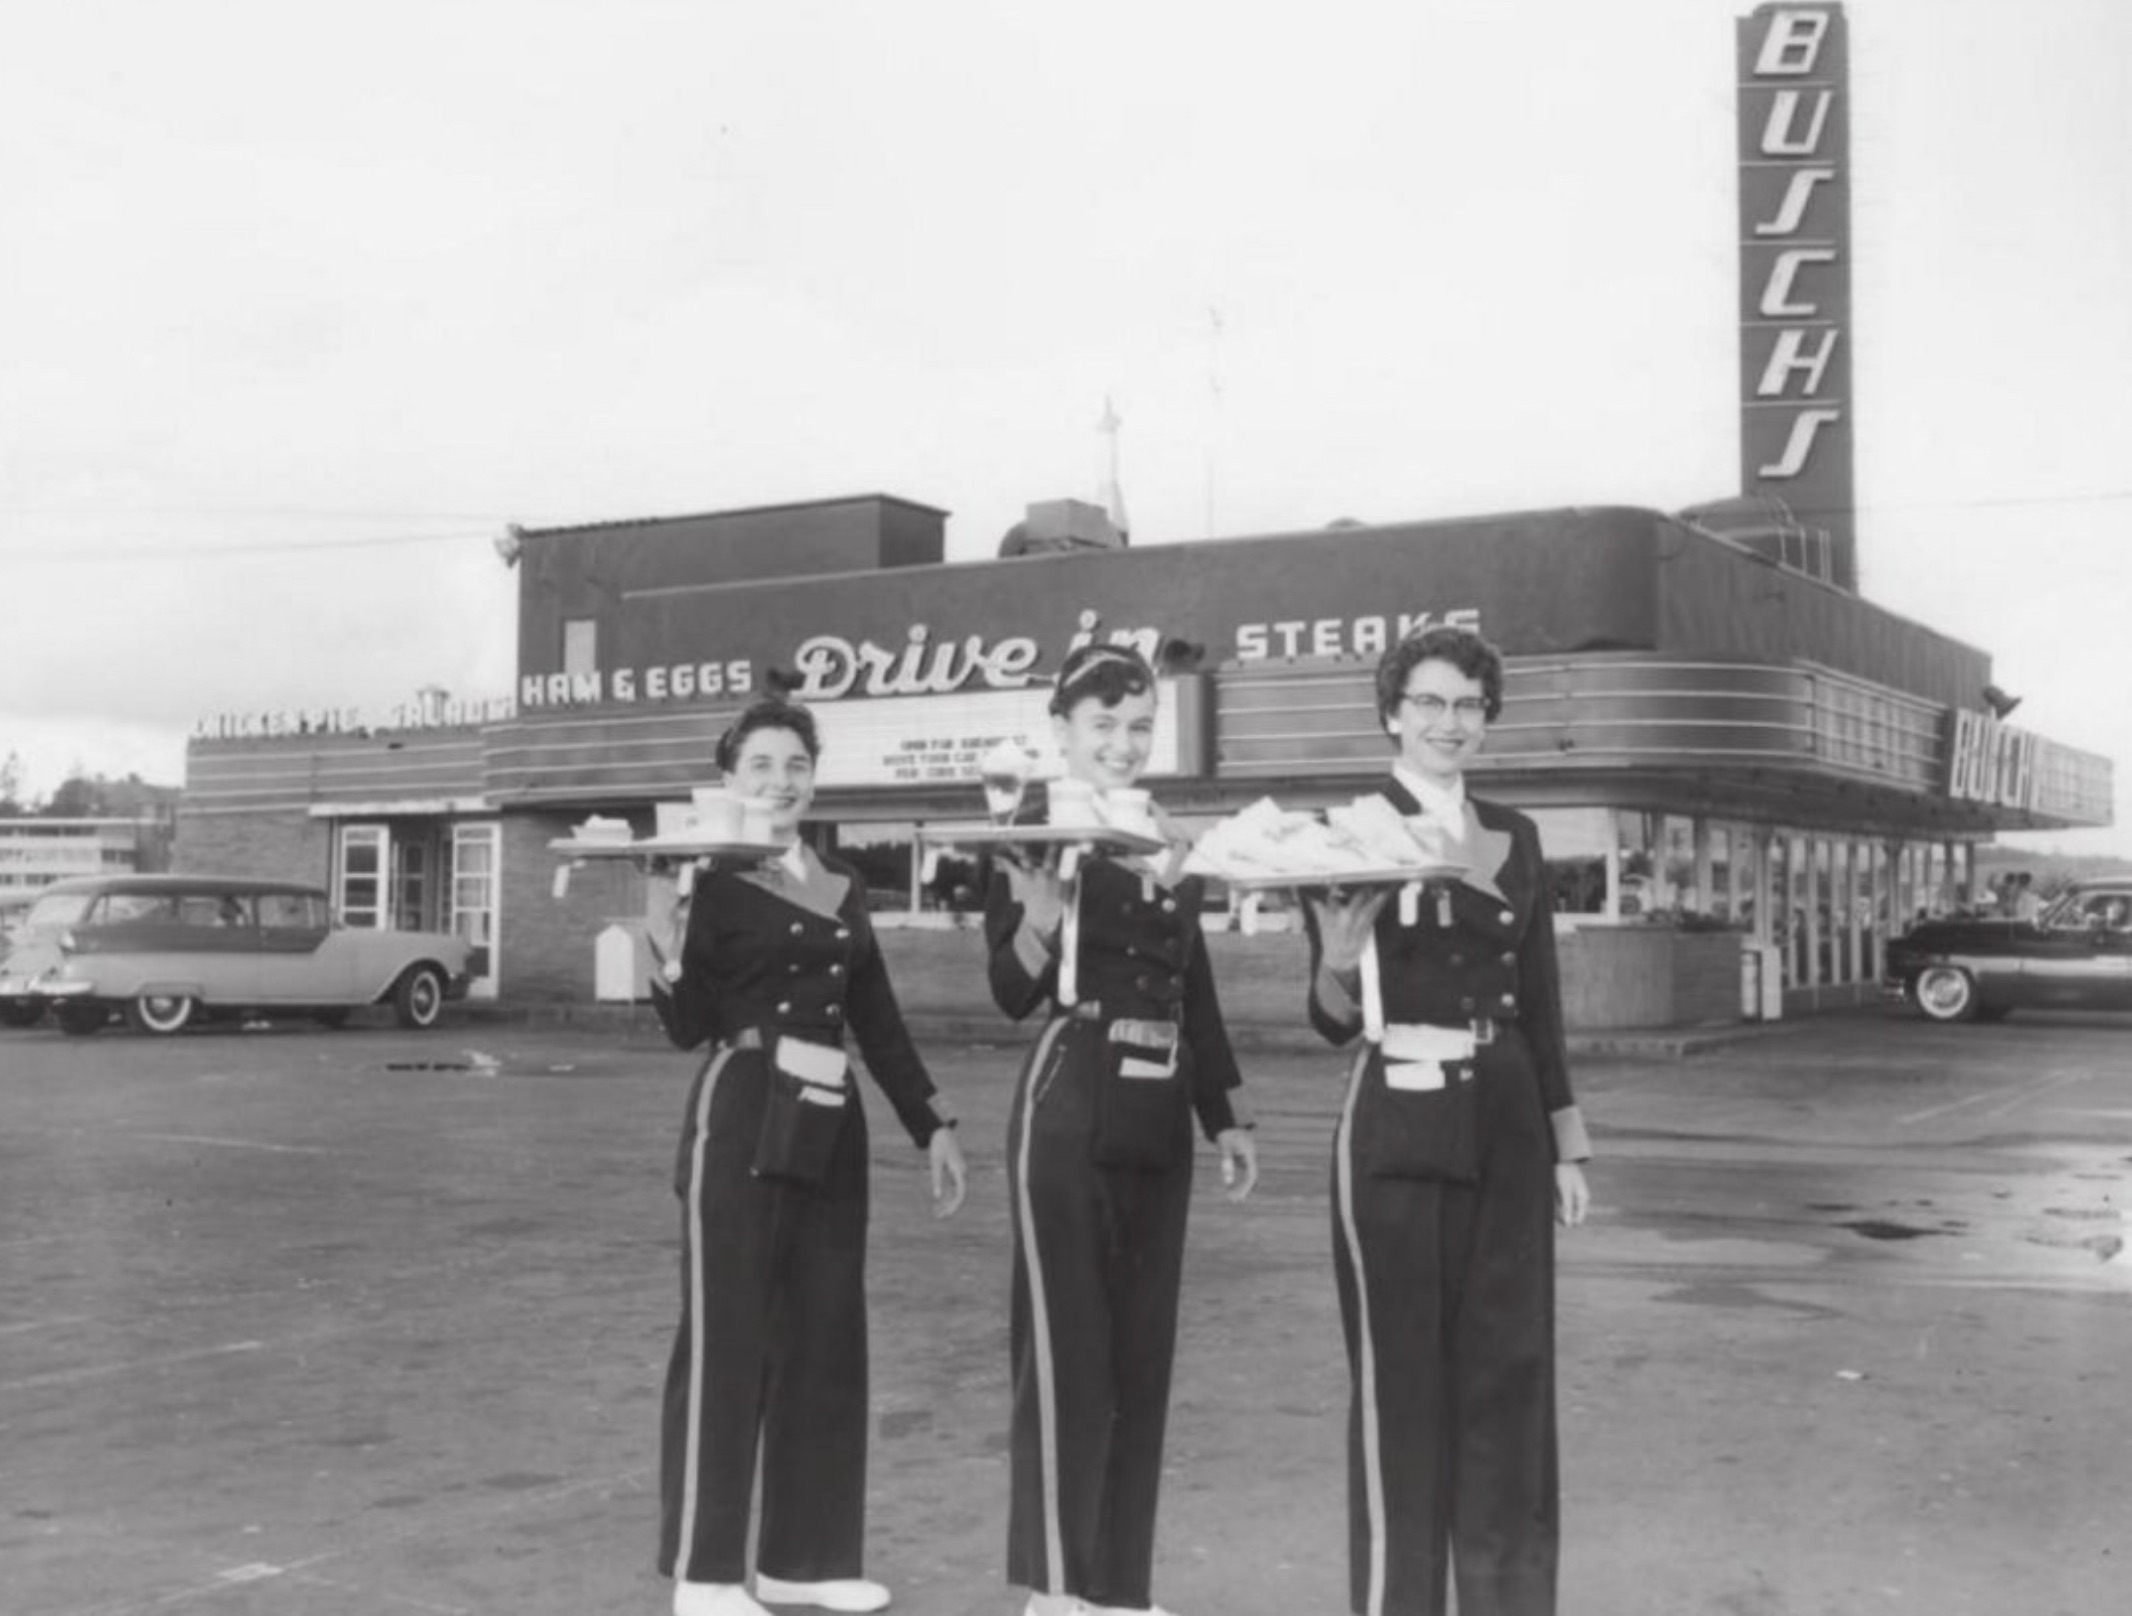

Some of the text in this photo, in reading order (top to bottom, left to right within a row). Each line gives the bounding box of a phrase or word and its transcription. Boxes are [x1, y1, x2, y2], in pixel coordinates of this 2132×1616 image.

[1753, 9, 1840, 478] BUSCHS
[522, 660, 752, 706] HAM & EGGS
[789, 622, 1040, 701] Drive
